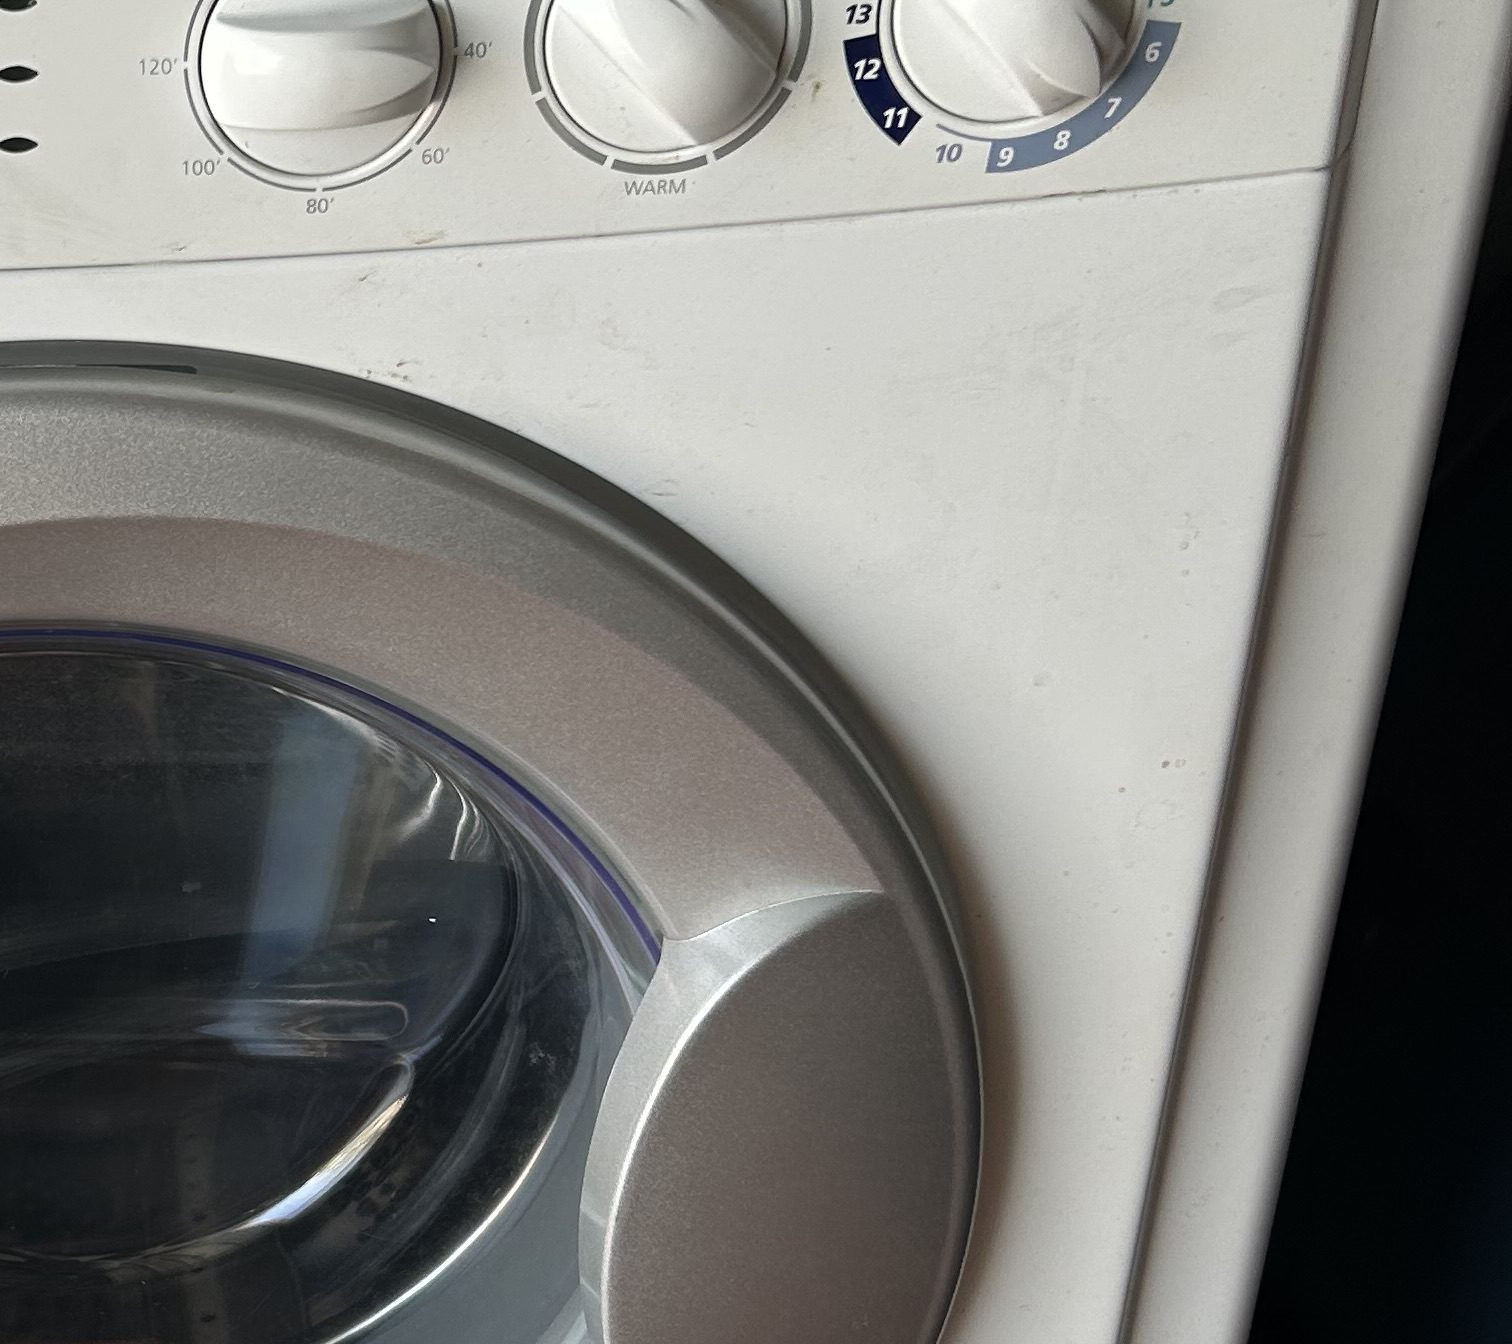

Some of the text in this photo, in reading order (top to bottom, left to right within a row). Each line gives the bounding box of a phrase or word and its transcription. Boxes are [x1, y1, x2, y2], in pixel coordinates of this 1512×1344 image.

[846, 3, 873, 25] 13
[1145, 41, 1162, 63] 6
[853, 57, 882, 81] 12
[882, 106, 909, 129] 11
[1104, 97, 1123, 119] 7
[1053, 129, 1072, 151] 8
[935, 143, 963, 164] 10
[996, 146, 1015, 168] 9
[624, 178, 687, 196] WARM
